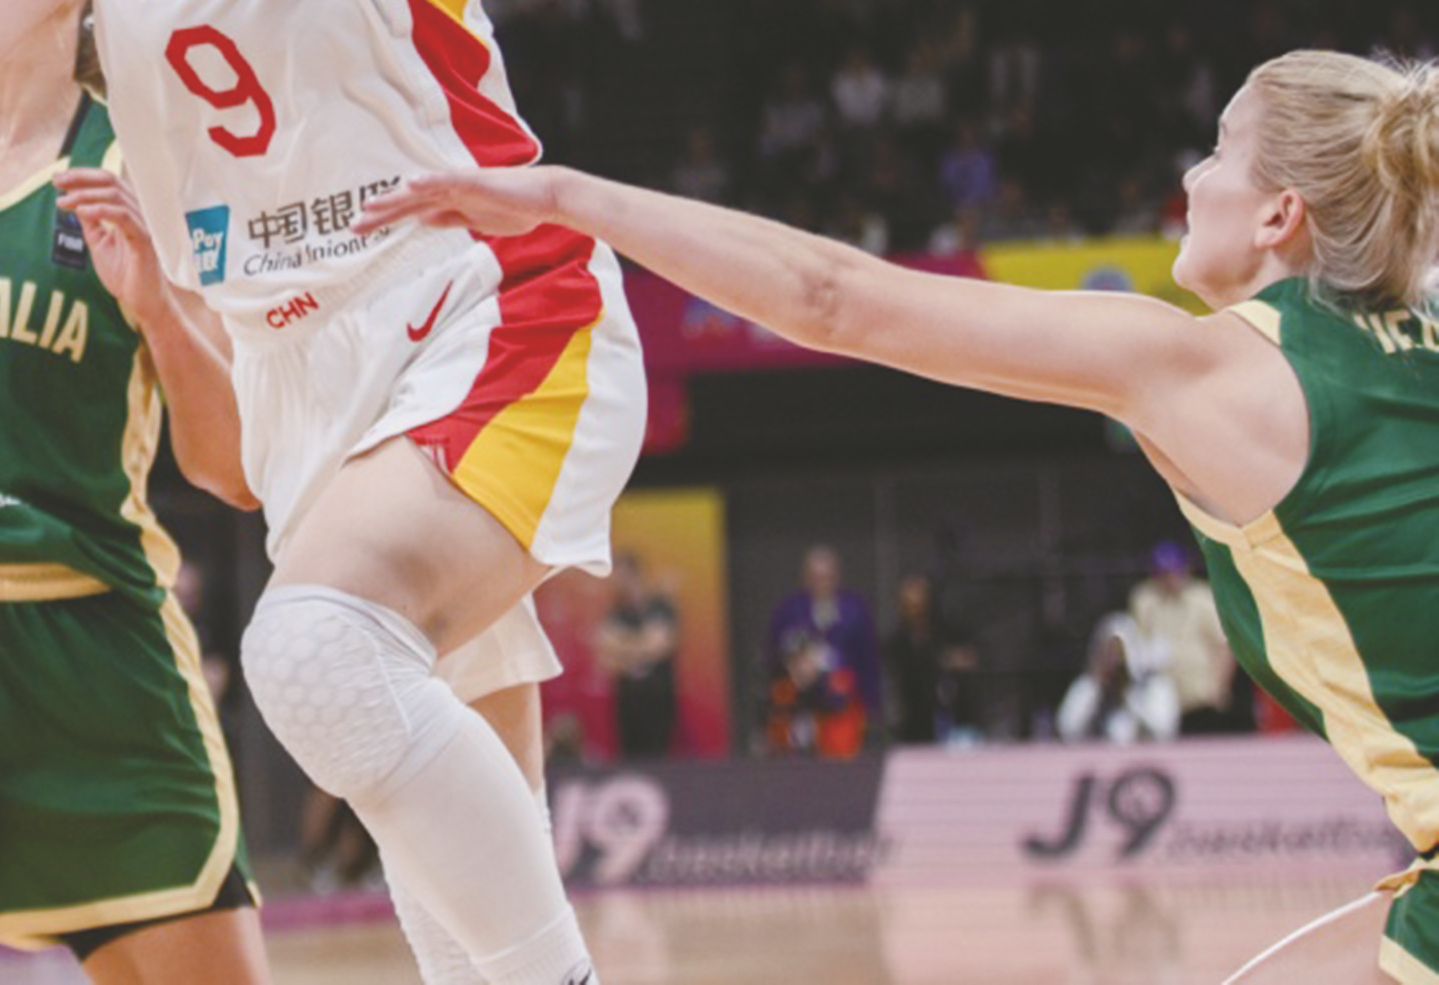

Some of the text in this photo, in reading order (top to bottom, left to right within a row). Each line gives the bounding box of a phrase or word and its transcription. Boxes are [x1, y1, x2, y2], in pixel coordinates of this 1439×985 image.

[165, 24, 277, 158] 9
[247, 176, 401, 249] 中国银
[243, 226, 391, 276] Chinanion
[265, 291, 319, 330] CHN
[1021, 767, 1177, 860] J9
